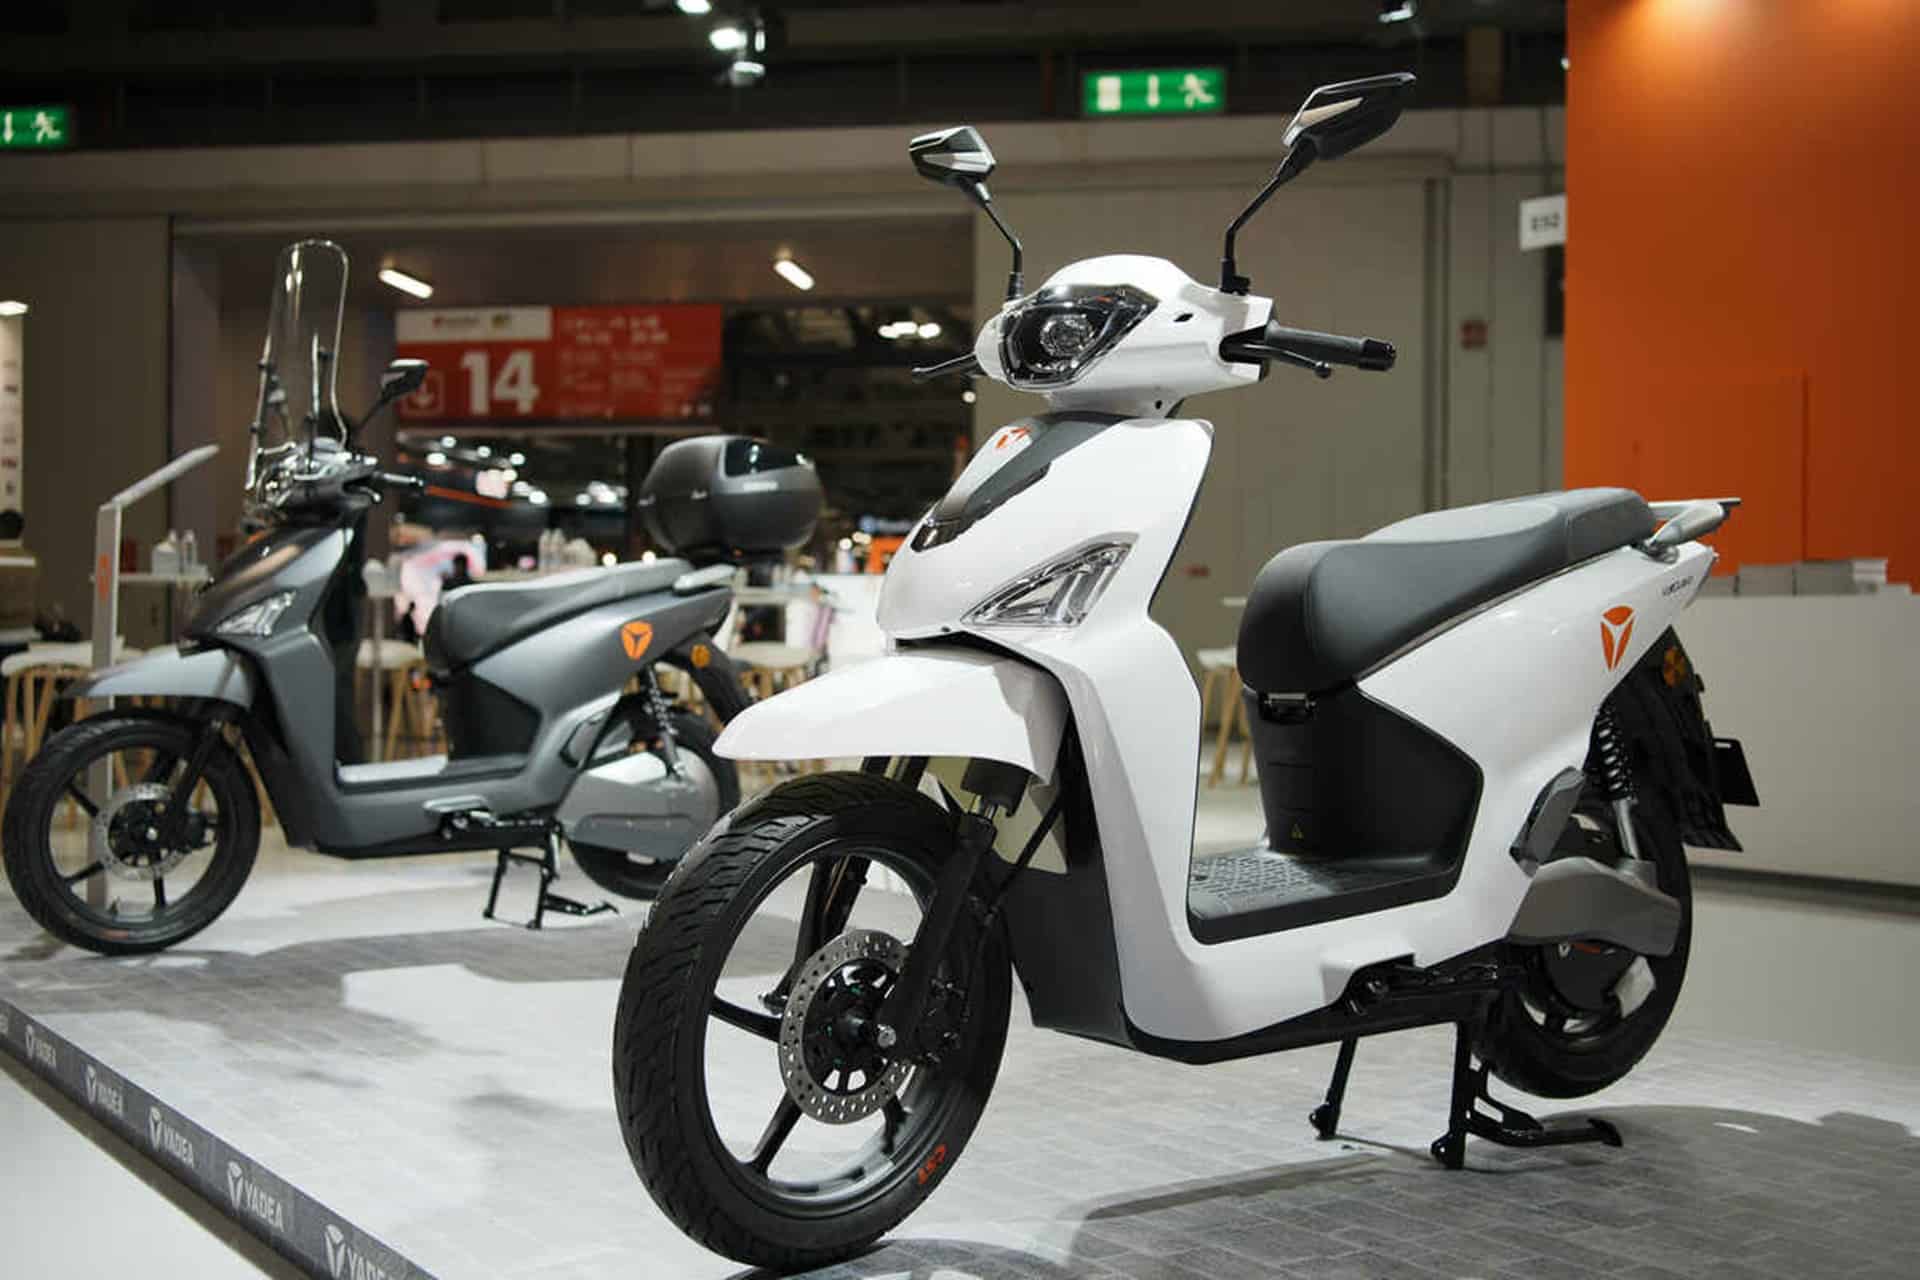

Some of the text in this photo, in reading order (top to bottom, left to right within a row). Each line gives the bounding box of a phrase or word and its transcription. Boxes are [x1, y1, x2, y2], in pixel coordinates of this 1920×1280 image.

[460, 350, 540, 415] 14
[163, 1121, 195, 1170] YADEA
[244, 1179, 285, 1233] YADEA
